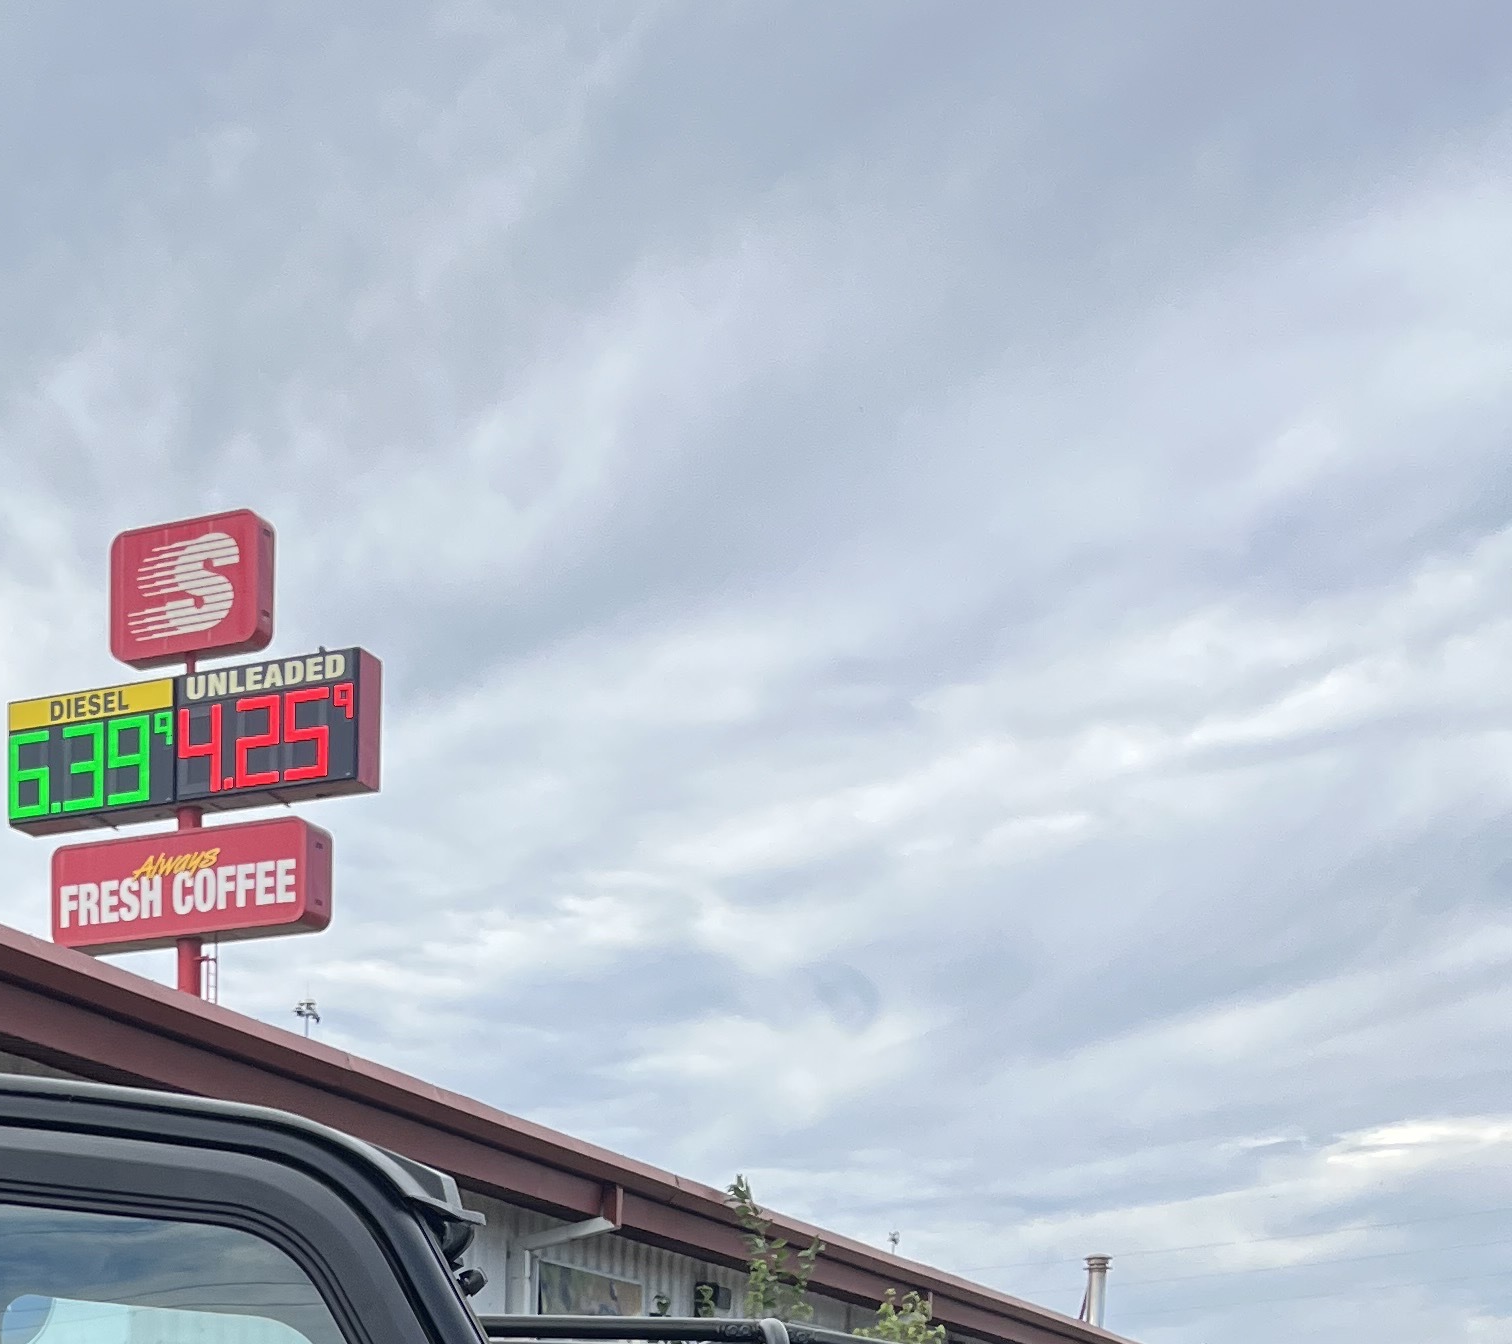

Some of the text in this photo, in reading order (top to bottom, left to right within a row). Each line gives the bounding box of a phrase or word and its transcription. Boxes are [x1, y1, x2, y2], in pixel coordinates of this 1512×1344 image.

[185, 653, 346, 700] UNLEADED
[49, 689, 130, 722] DIESEL
[132, 847, 221, 880] Always
[59, 858, 297, 928] FRESH COFFEE
